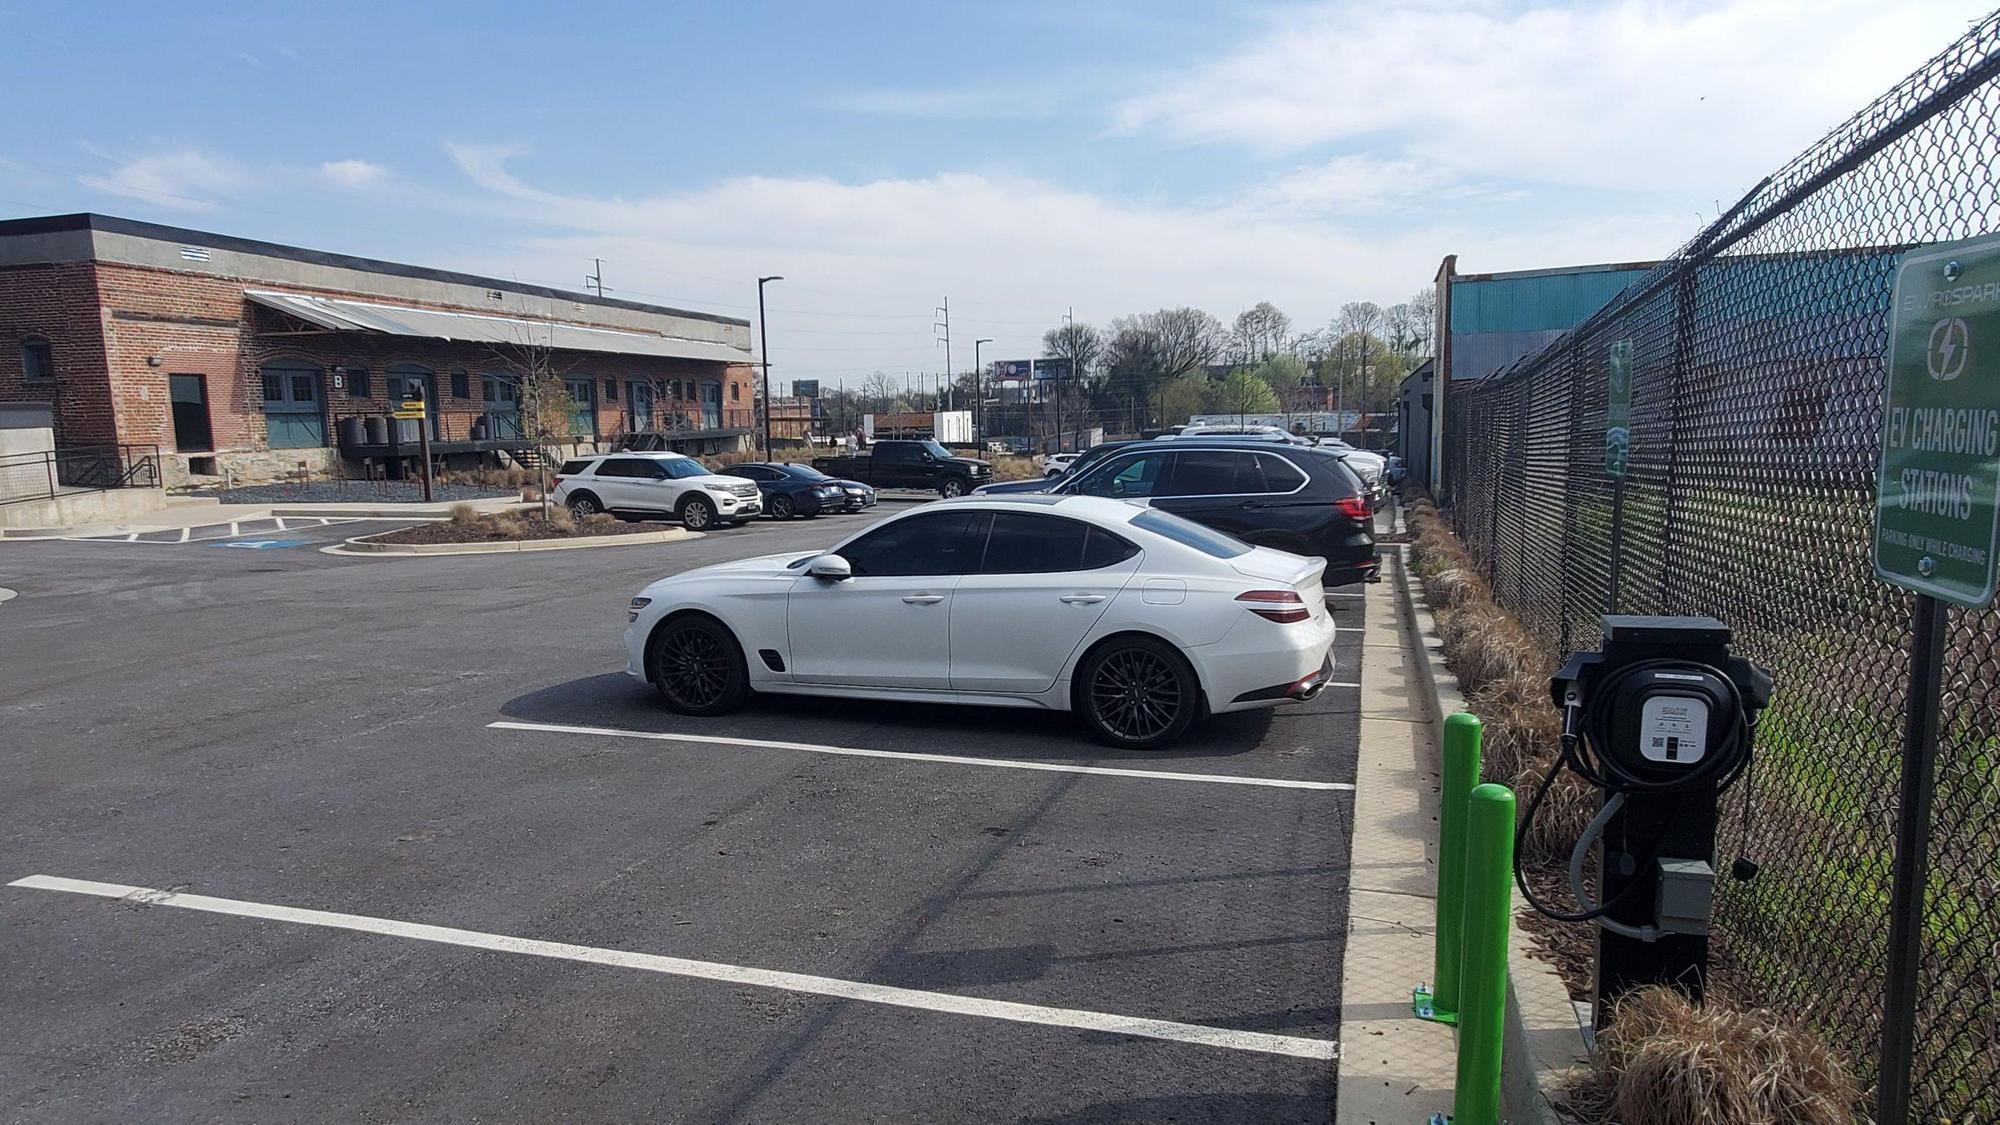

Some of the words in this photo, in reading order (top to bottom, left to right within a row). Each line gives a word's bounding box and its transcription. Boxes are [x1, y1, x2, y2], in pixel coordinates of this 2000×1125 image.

[1904, 282, 2000, 311] EVROSPAR
[334, 375, 343, 388] B
[1889, 407, 1910, 448] EV
[1911, 407, 1998, 456] CHARGING
[1899, 468, 1973, 520] STATIONS
[1908, 533, 1925, 551] ONLY
[1948, 542, 1986, 566] CHARGING
